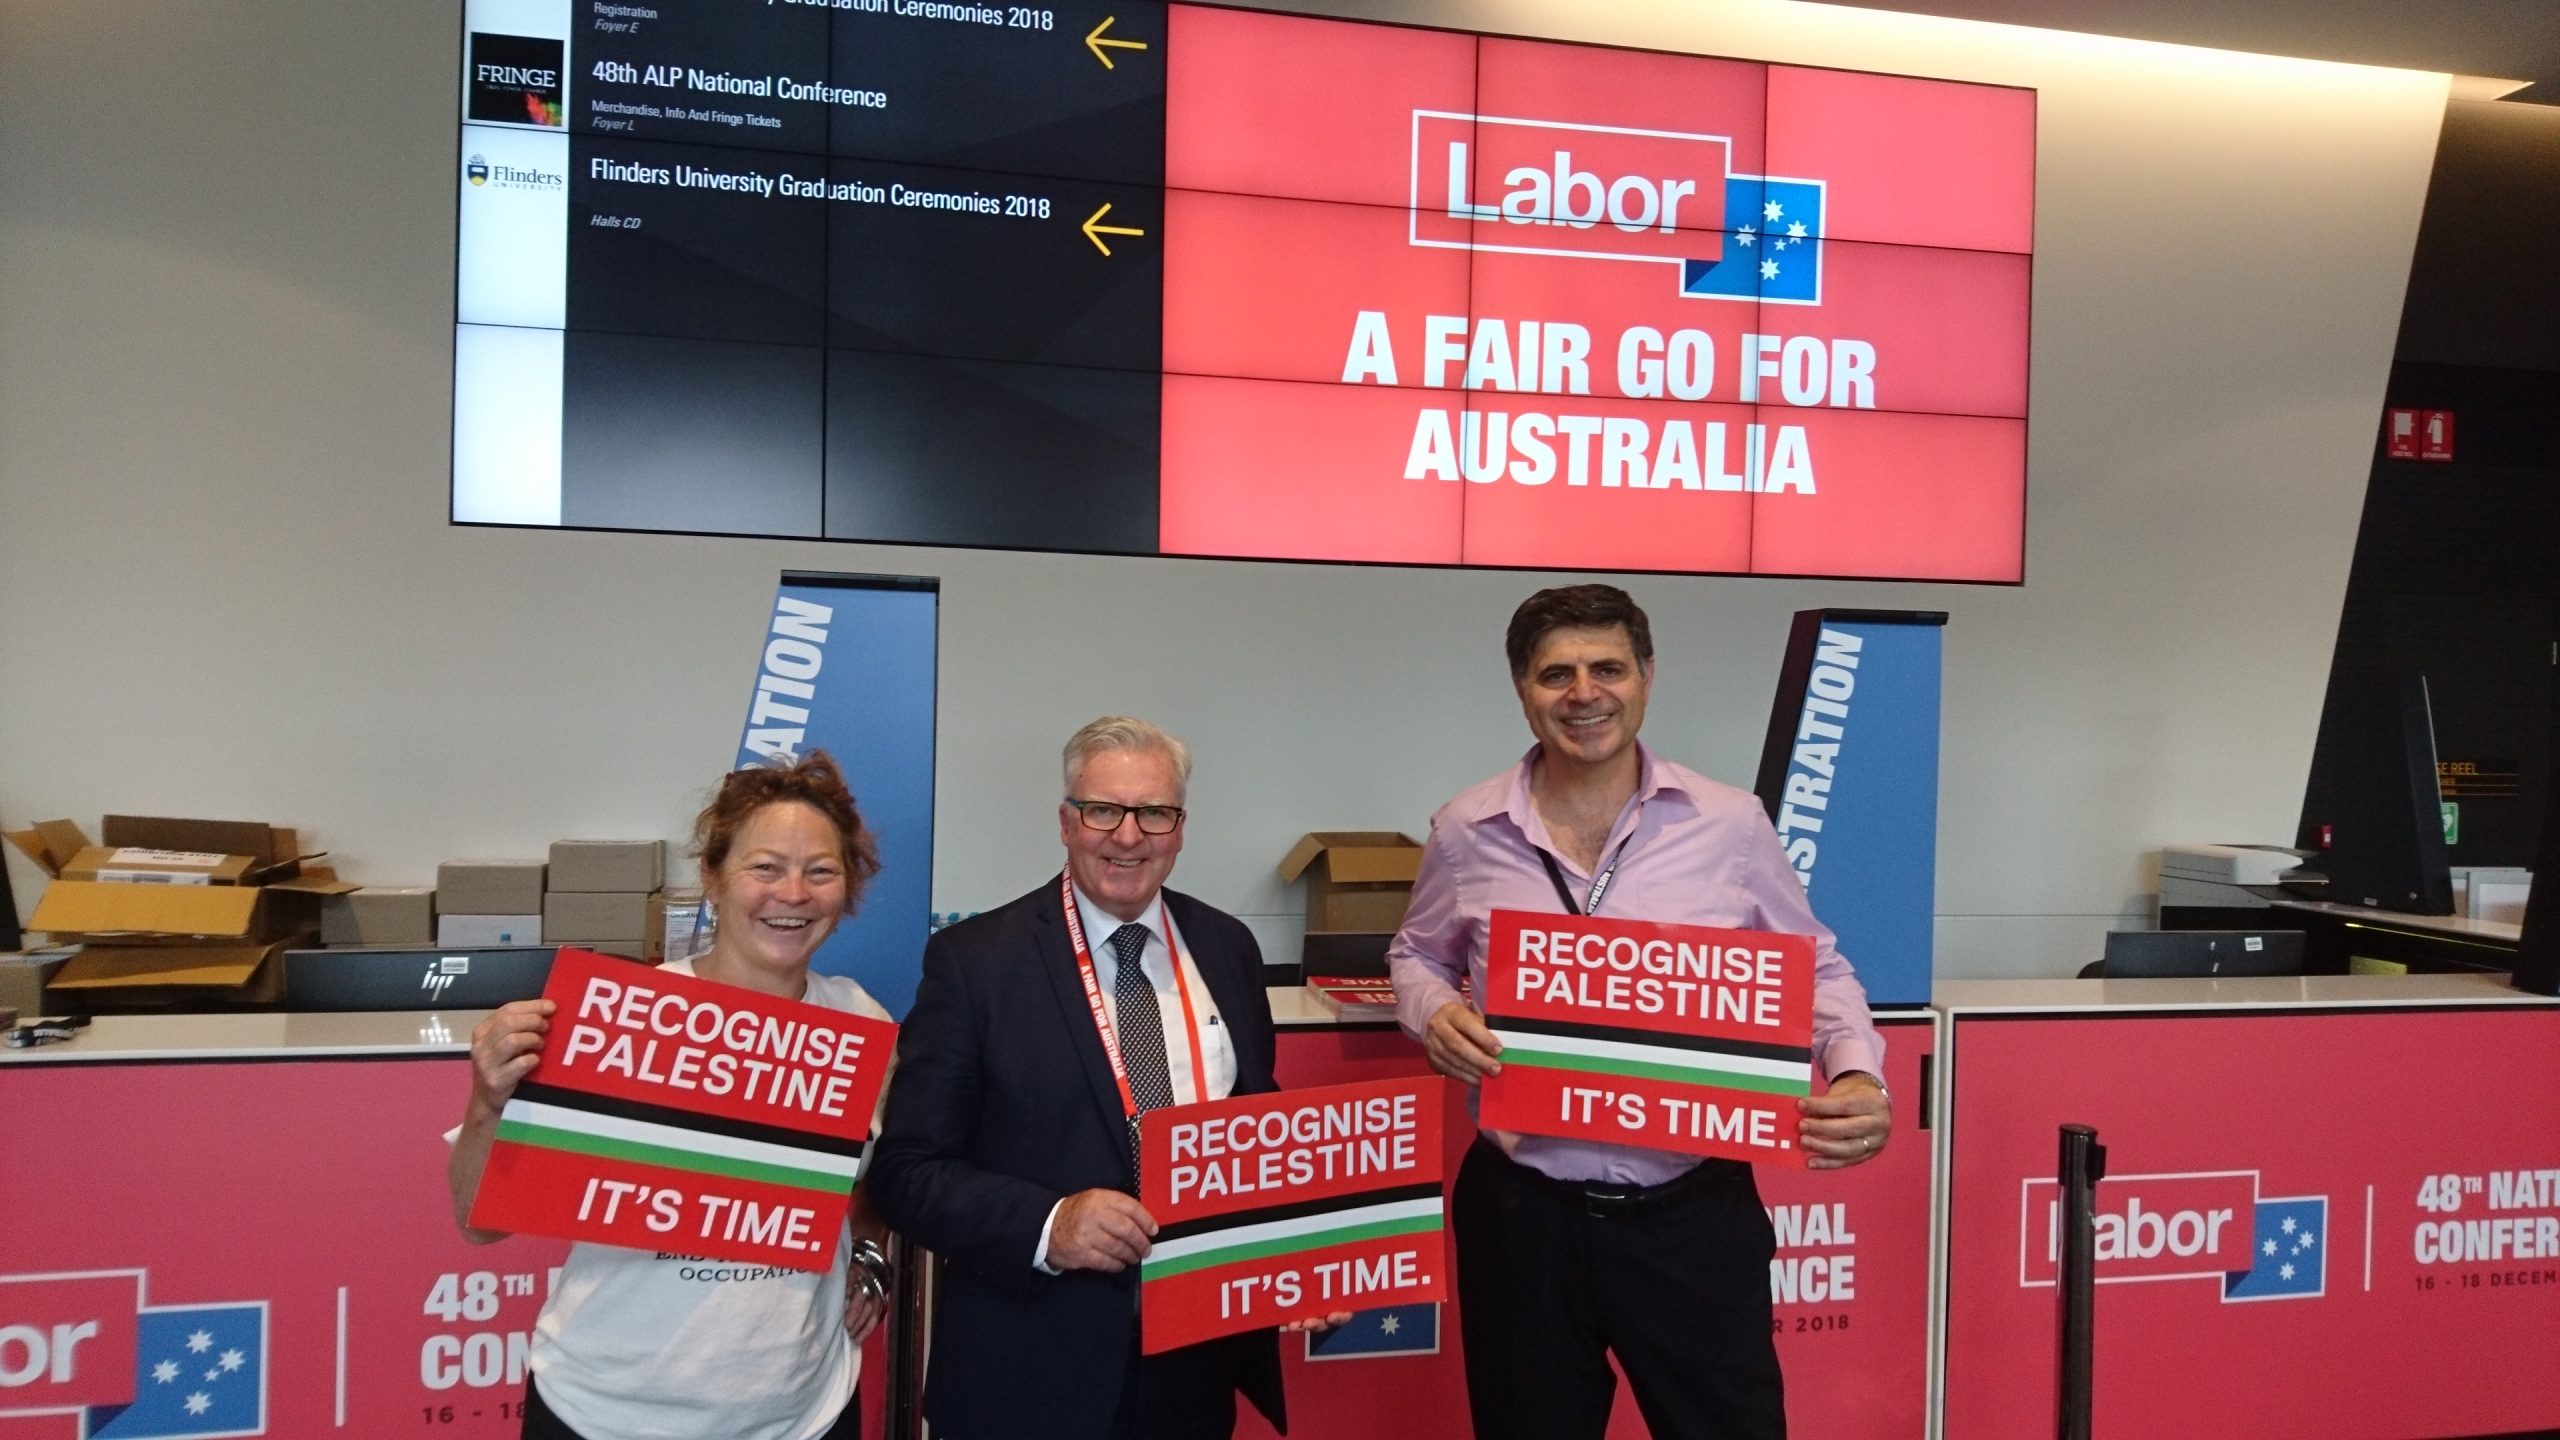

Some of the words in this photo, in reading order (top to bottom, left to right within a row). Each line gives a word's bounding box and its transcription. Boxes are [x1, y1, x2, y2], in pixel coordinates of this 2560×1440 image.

[594, 2, 657, 20] Registration
[594, 19, 627, 34] Foyer
[629, 21, 639, 34] E
[893, 0, 1003, 25] Ceremonies
[1008, 7, 1053, 31] 2018
[477, 64, 556, 87] FRINGE
[592, 61, 638, 84] 48th
[643, 65, 683, 88] ALP
[687, 68, 771, 97] National
[777, 76, 887, 109] Conference
[592, 100, 663, 119] Merchandise,
[665, 107, 687, 120] Info
[687, 108, 709, 122] And
[711, 111, 744, 127] Fringe
[746, 114, 782, 128] Tickets
[592, 116, 627, 132] Foyer
[627, 120, 635, 132] L
[494, 166, 563, 186] Flinders
[591, 157, 671, 186] Flinders
[675, 165, 775, 198] University
[779, 174, 886, 204] Graduation
[890, 183, 1000, 215] Ceremonies
[1005, 195, 1051, 219] 2018
[1448, 141, 1695, 235] Labor
[590, 214, 622, 229] Halls
[623, 217, 641, 230] CD
[1341, 310, 1398, 385] A
[1423, 314, 1591, 396] FAIR
[1617, 326, 1715, 402] GO
[1739, 333, 1877, 409] FOR
[1403, 408, 1817, 495] AUSTRALIA
[742, 597, 833, 771] ATION
[1063, 891, 1075, 910] FOR
[1066, 909, 1085, 954] AUSTRALIA
[1080, 965, 1091, 974] A
[1518, 929, 1783, 986] RECOGNISE
[1083, 973, 1097, 995] FAIR
[1089, 994, 1102, 1009] GO
[1516, 967, 1781, 1027] PALESTINE
[578, 977, 865, 1074] RECOGNISE
[1094, 1008, 1108, 1028] FOR
[562, 1024, 852, 1118] PALESTINE
[1100, 1028, 1125, 1080] AUSTRALIA
[1171, 1094, 1416, 1162] RECOGNISE
[1560, 1086, 1646, 1129] IT'S
[1660, 1098, 1790, 1149] TIME.
[1171, 1134, 1416, 1205] PALESTINE
[577, 1177, 682, 1233] IT'S
[698, 1194, 821, 1252] TIME.
[1221, 1270, 1302, 1319] IT'S
[1313, 1251, 1430, 1299] TIME.
[2416, 1276, 2435, 1291] 16
[2462, 1273, 2480, 1288] 18
[2490, 1270, 2560, 1287] DECEM
[1795, 1314, 1849, 1333] 2018
[423, 1406, 454, 1424] 16
